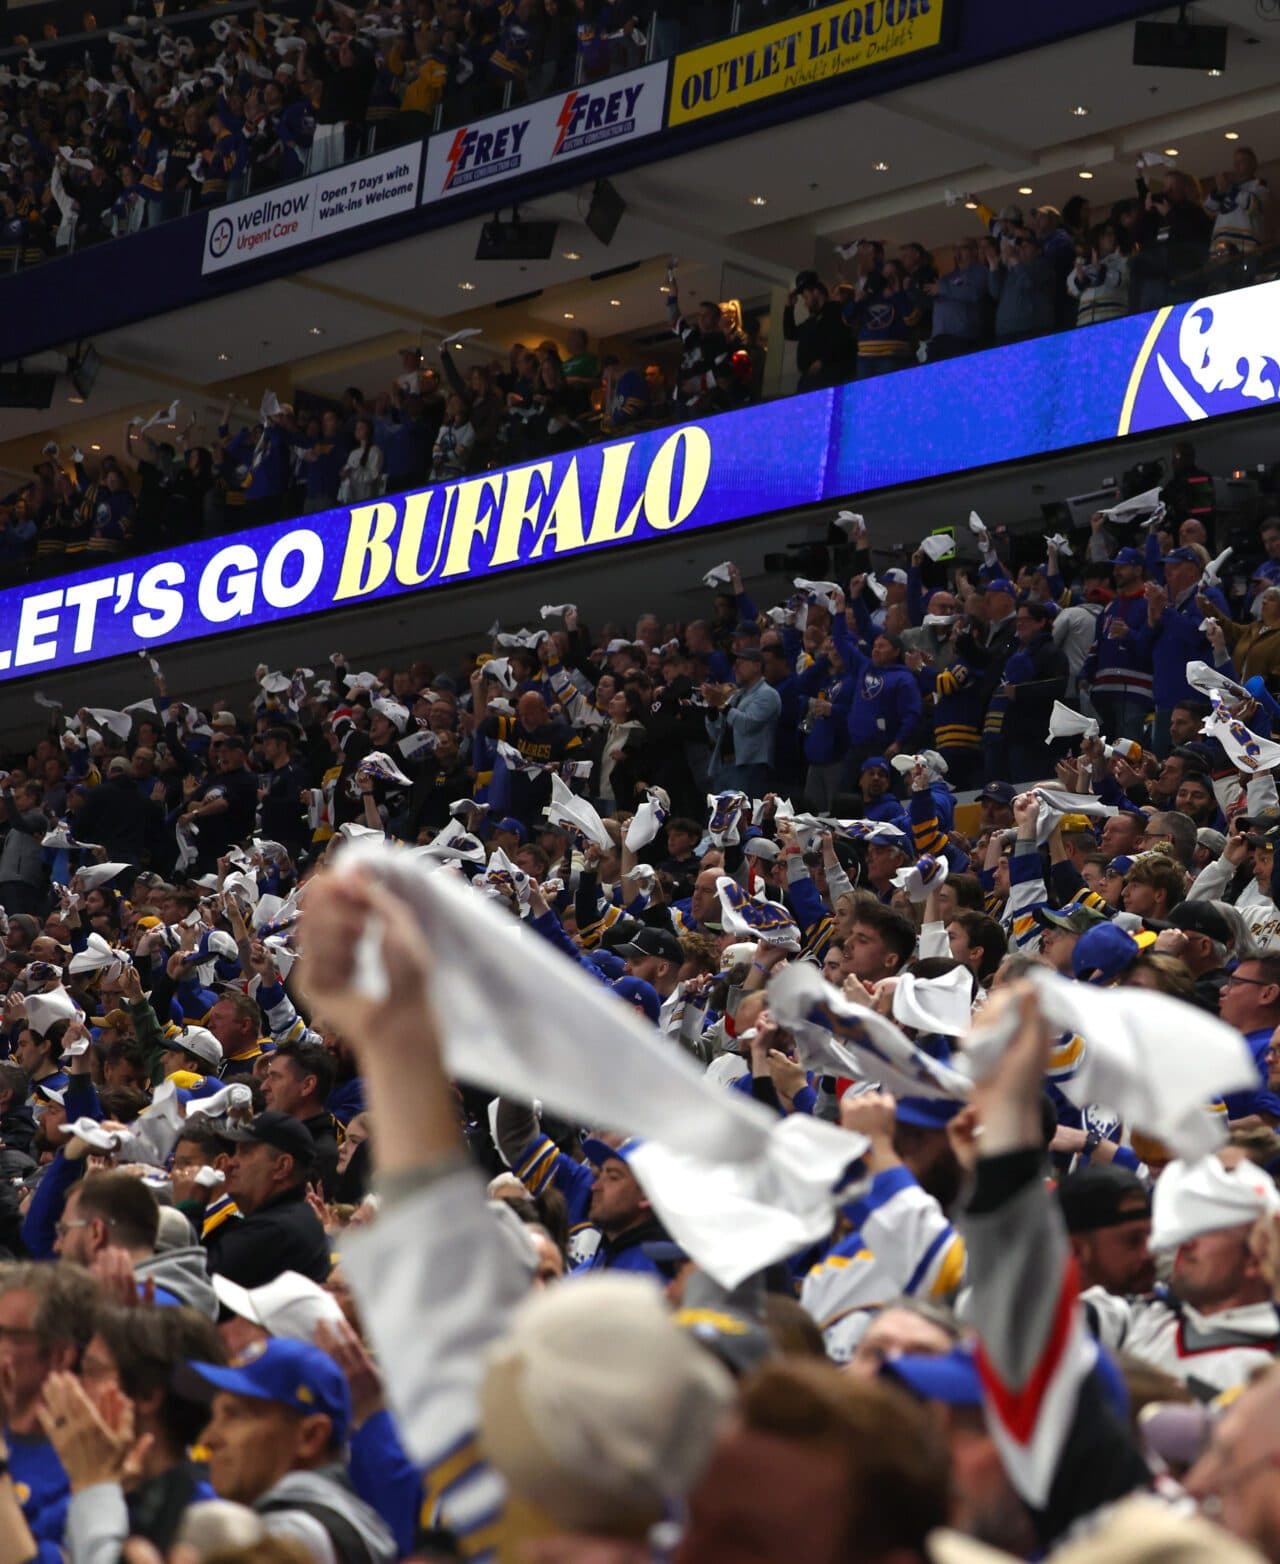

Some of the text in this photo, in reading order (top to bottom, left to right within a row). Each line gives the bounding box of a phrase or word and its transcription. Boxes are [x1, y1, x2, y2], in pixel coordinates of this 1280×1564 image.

[681, 31, 802, 110] OUTLET
[566, 83, 645, 137] FREY
[457, 120, 531, 171] FREY
[319, 181, 414, 221] Walk-ins Welcome
[321, 165, 410, 204] Open 7 Days with
[236, 220, 299, 250] Urgent Care
[237, 194, 310, 232] wellnow
[0, 426, 711, 671] ET'S GO BUFFALO
